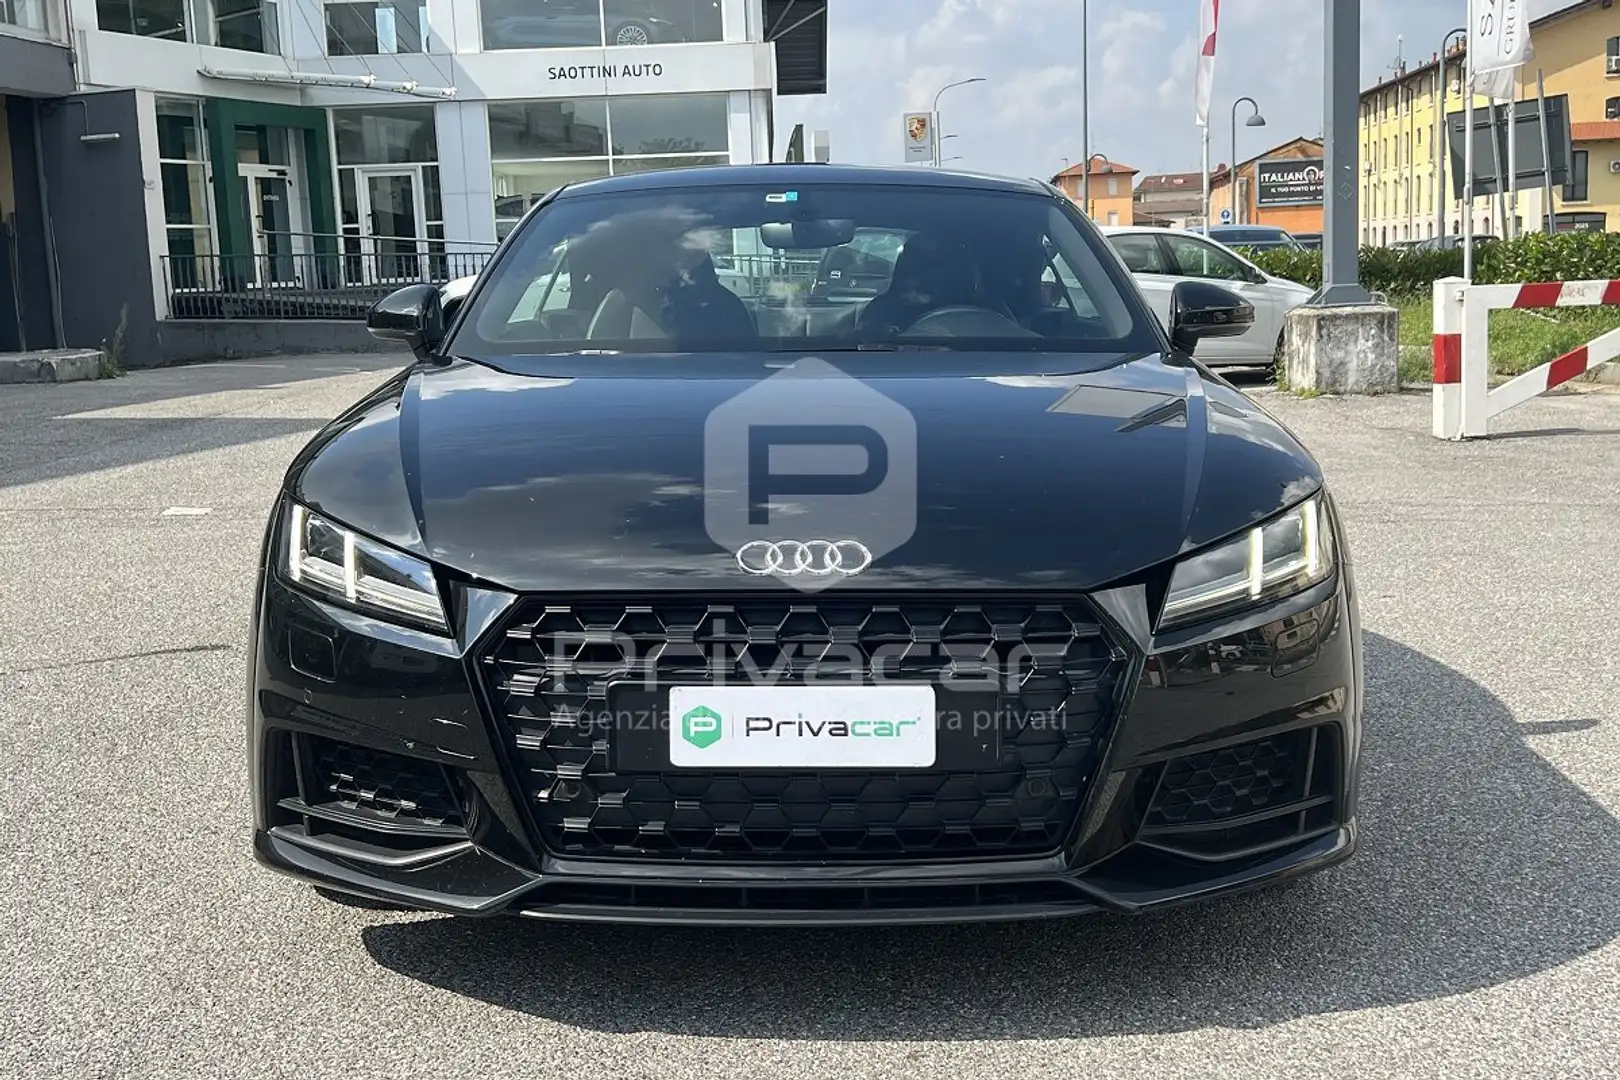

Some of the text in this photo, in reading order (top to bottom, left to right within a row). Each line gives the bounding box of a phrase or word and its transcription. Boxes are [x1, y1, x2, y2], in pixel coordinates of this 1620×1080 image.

[548, 63, 663, 80] SAOTTINI AUTO
[745, 713, 917, 738] Privacar
